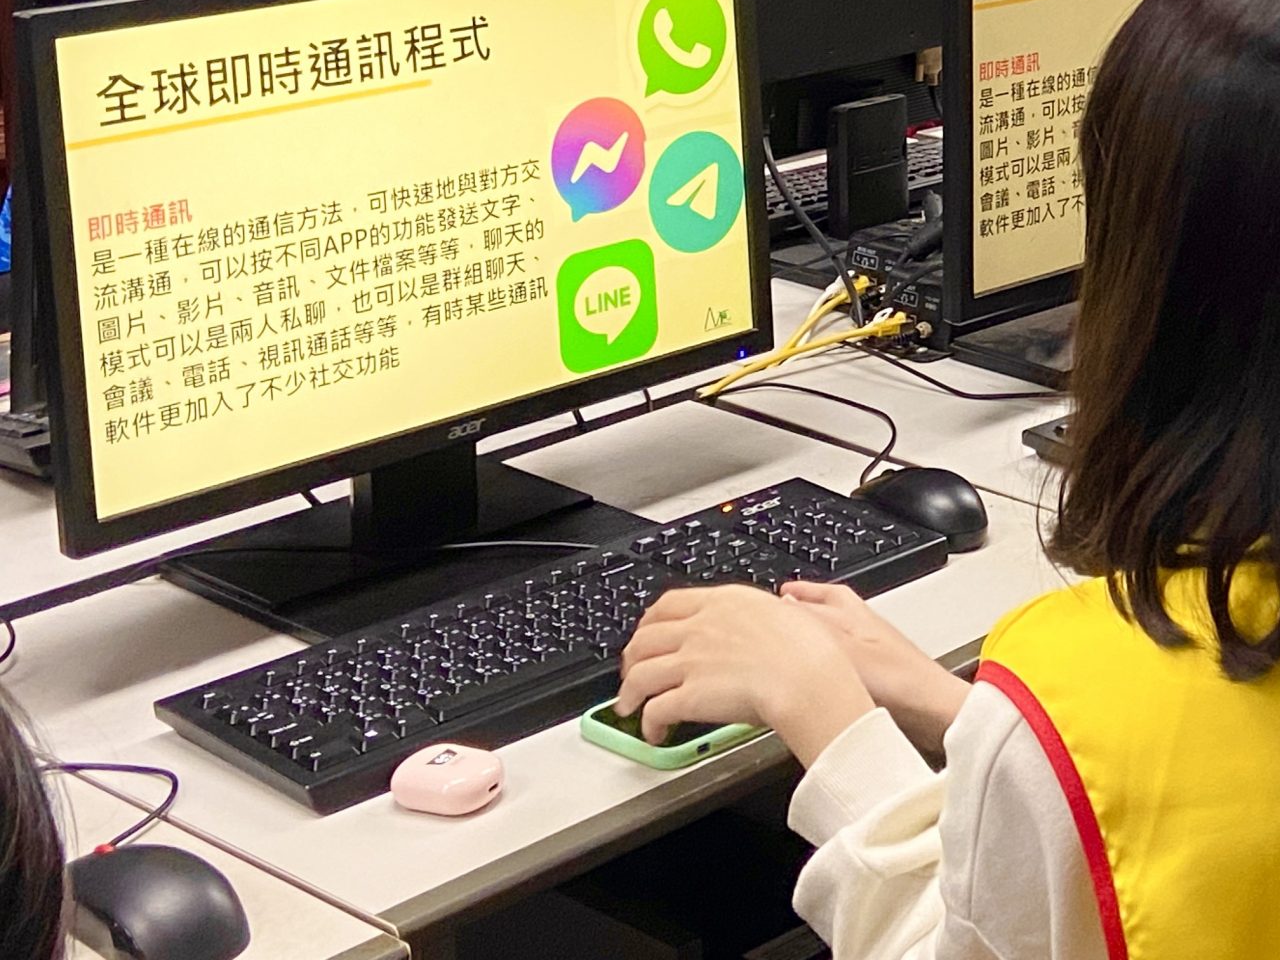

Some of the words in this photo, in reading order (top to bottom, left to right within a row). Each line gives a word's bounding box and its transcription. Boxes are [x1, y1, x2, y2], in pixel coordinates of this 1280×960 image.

[96, 15, 490, 127] 全球即時通訊程式
[979, 52, 1040, 81] 即時通訊
[87, 199, 193, 241] 即時通訊
[585, 285, 631, 316] LINE
[105, 346, 400, 444] 軟件更加入了不少社交功能
[447, 417, 486, 440] acer
[740, 496, 781, 516] acer
